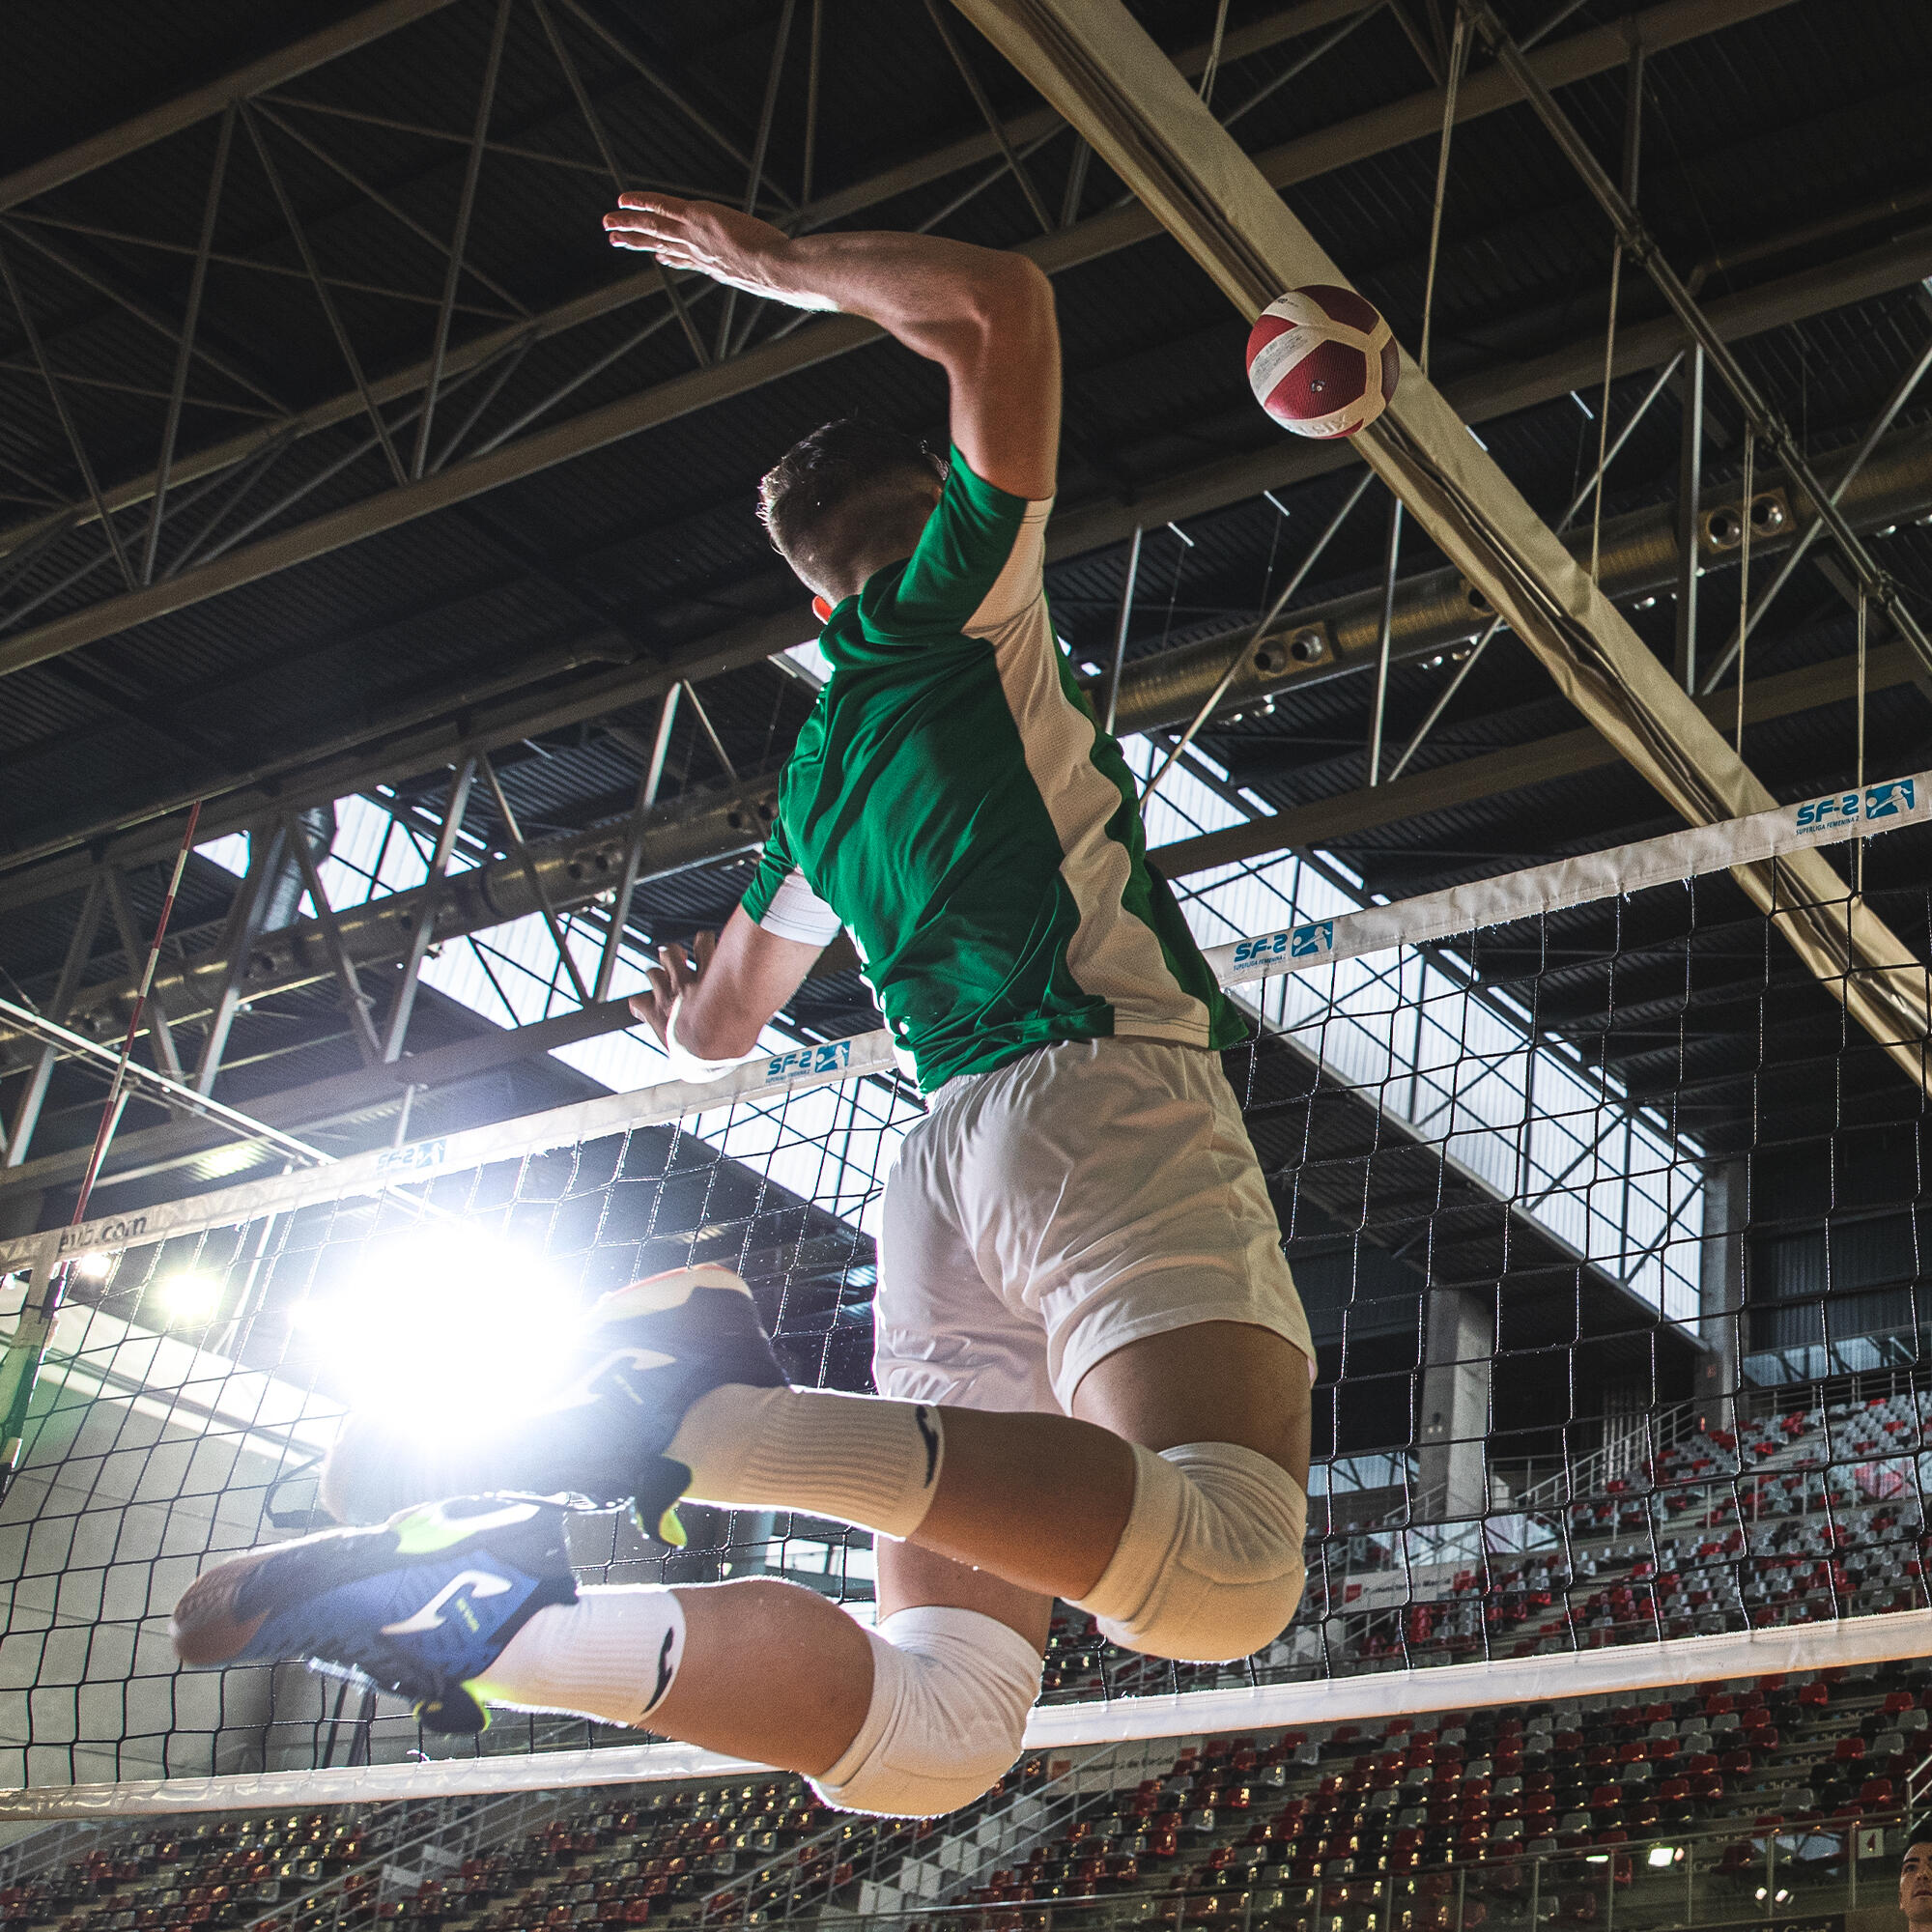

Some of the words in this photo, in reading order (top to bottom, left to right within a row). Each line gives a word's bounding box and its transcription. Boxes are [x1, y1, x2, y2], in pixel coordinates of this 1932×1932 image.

[1796, 793, 1859, 827] SF-2
[1796, 824, 1826, 836] SUPERLIGA
[1827, 817, 1855, 829] FEMENINA
[1234, 933, 1288, 962] SF-2
[767, 1050, 812, 1076] SF-2
